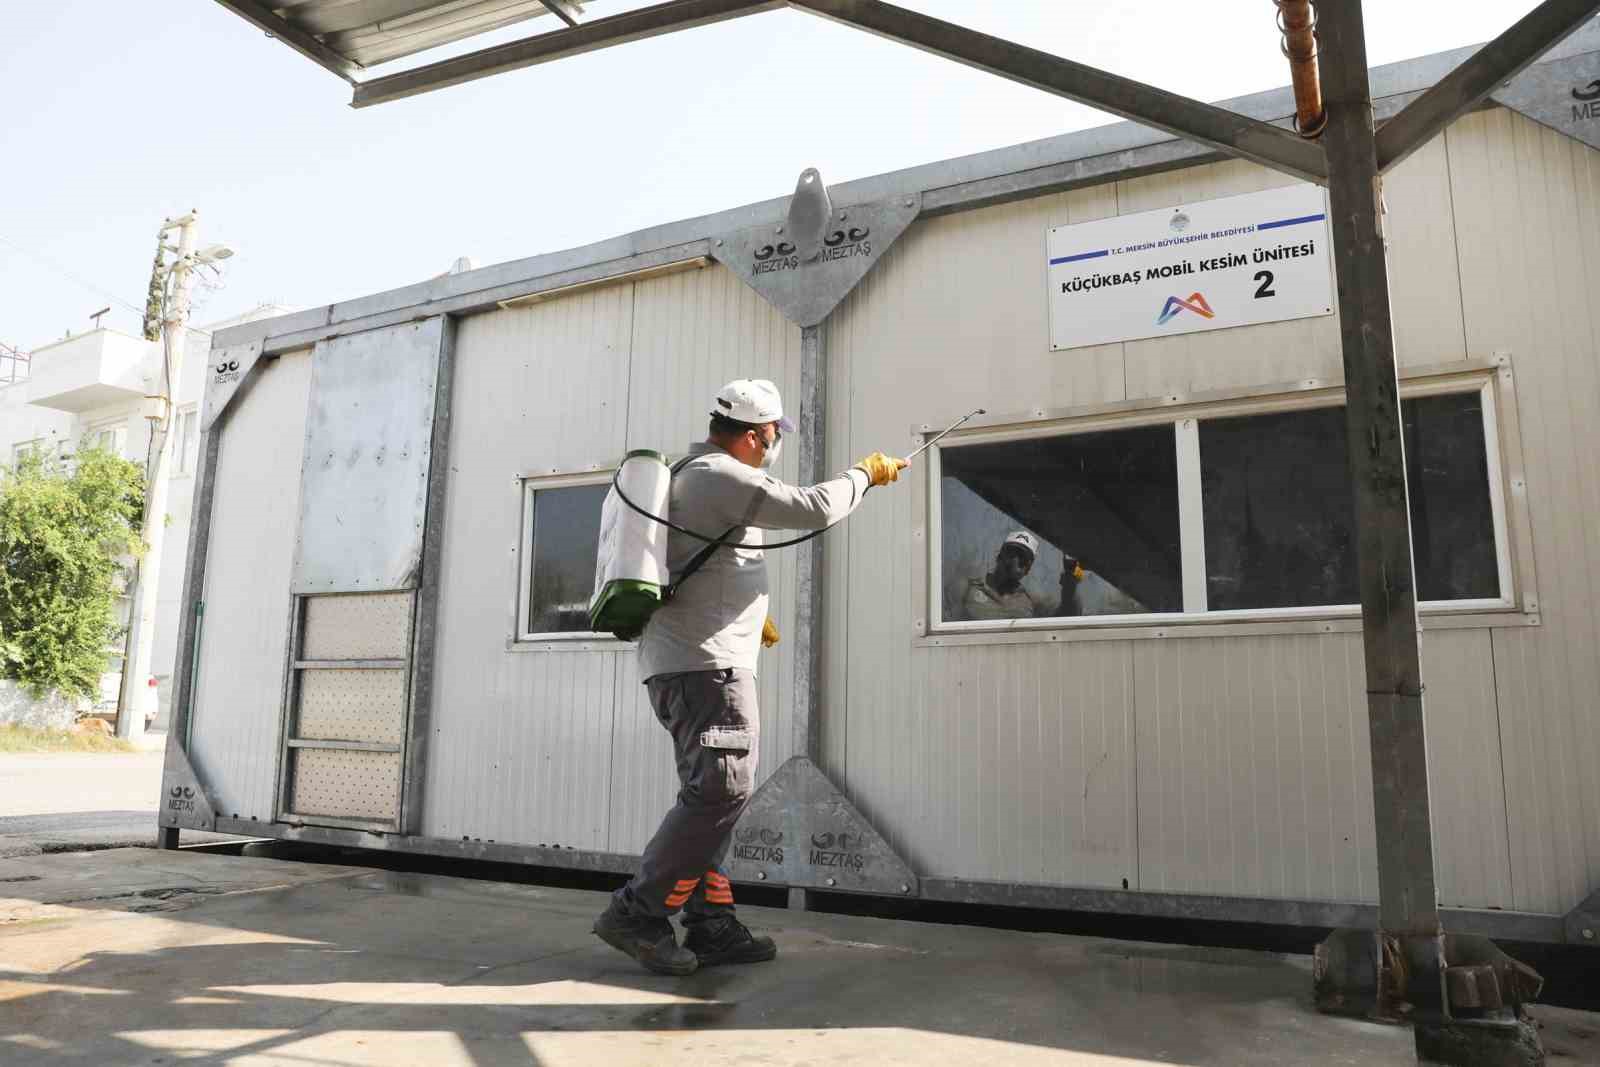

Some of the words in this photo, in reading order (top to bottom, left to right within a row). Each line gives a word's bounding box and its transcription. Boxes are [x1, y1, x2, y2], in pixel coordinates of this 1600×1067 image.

[1111, 248, 1125, 256] T.C.
[1126, 241, 1156, 253] MERSİN
[1157, 233, 1208, 248] BÜYÜKŞEHİR
[1210, 225, 1255, 239] BELEDİYESİ
[821, 241, 871, 263] MEZTAŞ
[752, 255, 799, 276] MEZTAŞ
[1062, 270, 1141, 293] KÜÇÜKBAŞ
[1146, 260, 1195, 280] MOBİL
[1199, 253, 1248, 272] KESİM
[1253, 240, 1314, 263] ÜNİTESİ
[1253, 270, 1276, 299] 2
[734, 845, 784, 864] MEZTAŞ
[809, 850, 864, 872] MEZTAŞ
